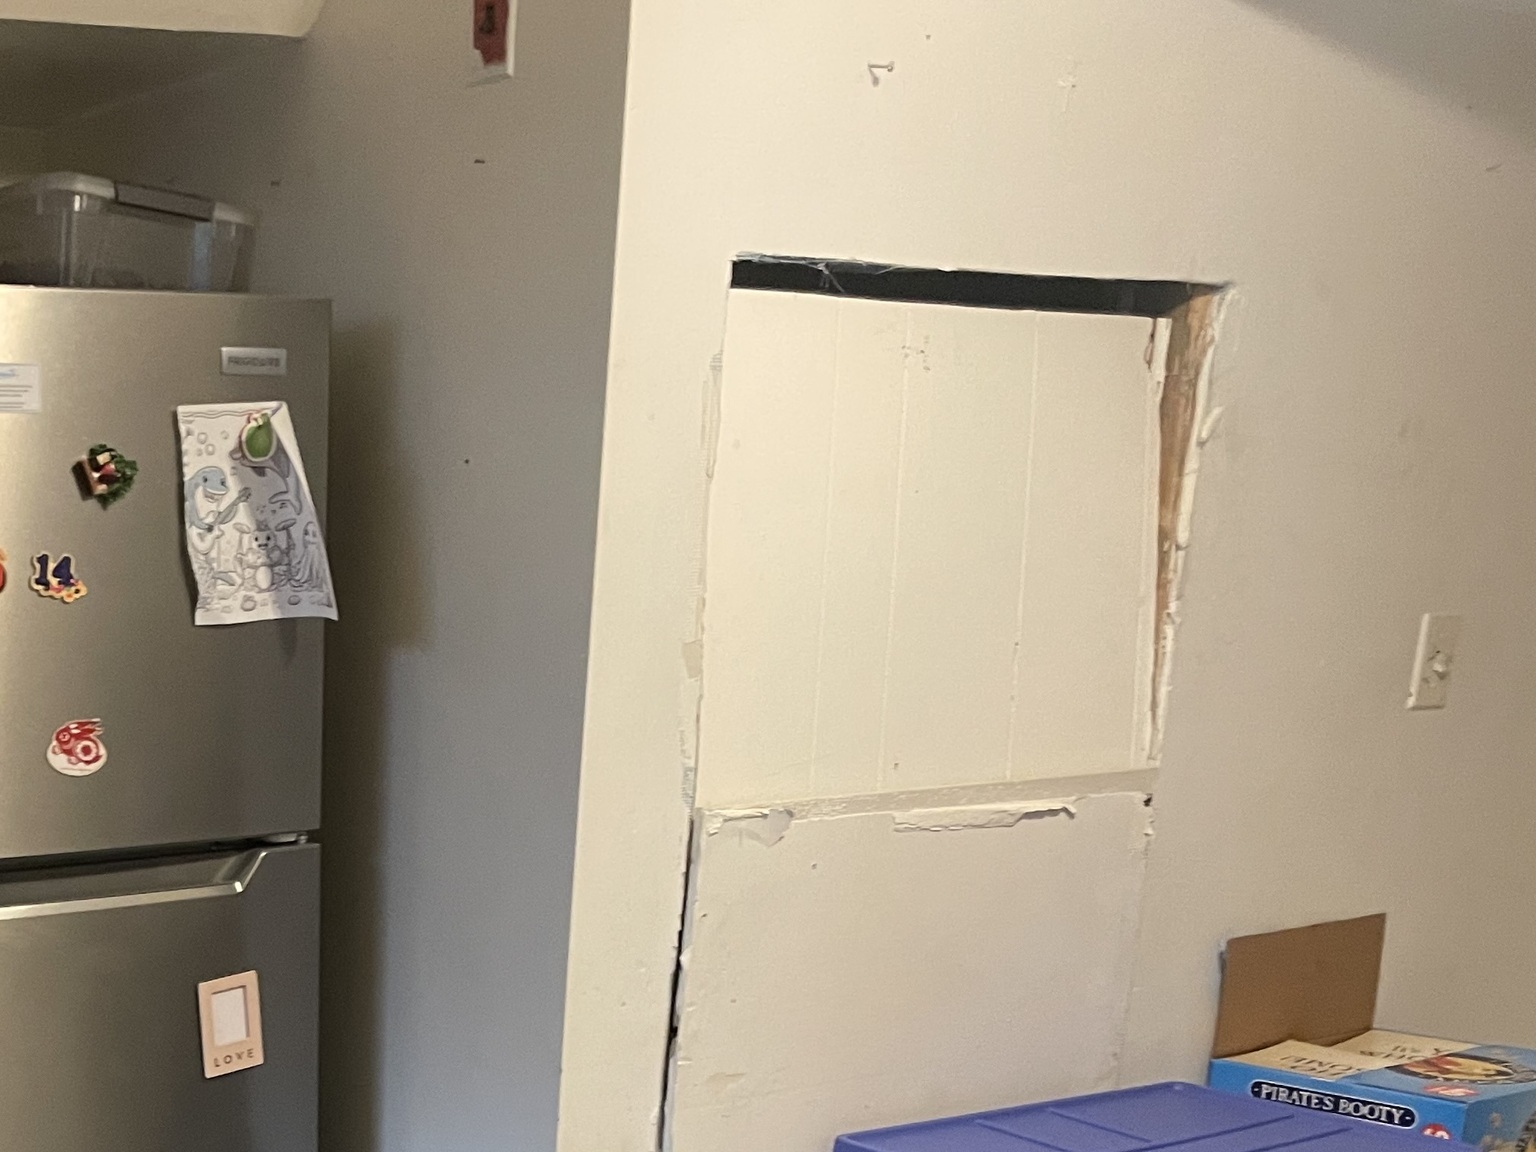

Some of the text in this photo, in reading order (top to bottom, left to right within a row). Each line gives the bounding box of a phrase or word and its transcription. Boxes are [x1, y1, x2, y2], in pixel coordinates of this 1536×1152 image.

[35, 553, 74, 591] 14
[213, 1048, 255, 1068] LOVE
[1337, 1098, 1404, 1125] BOOTY
